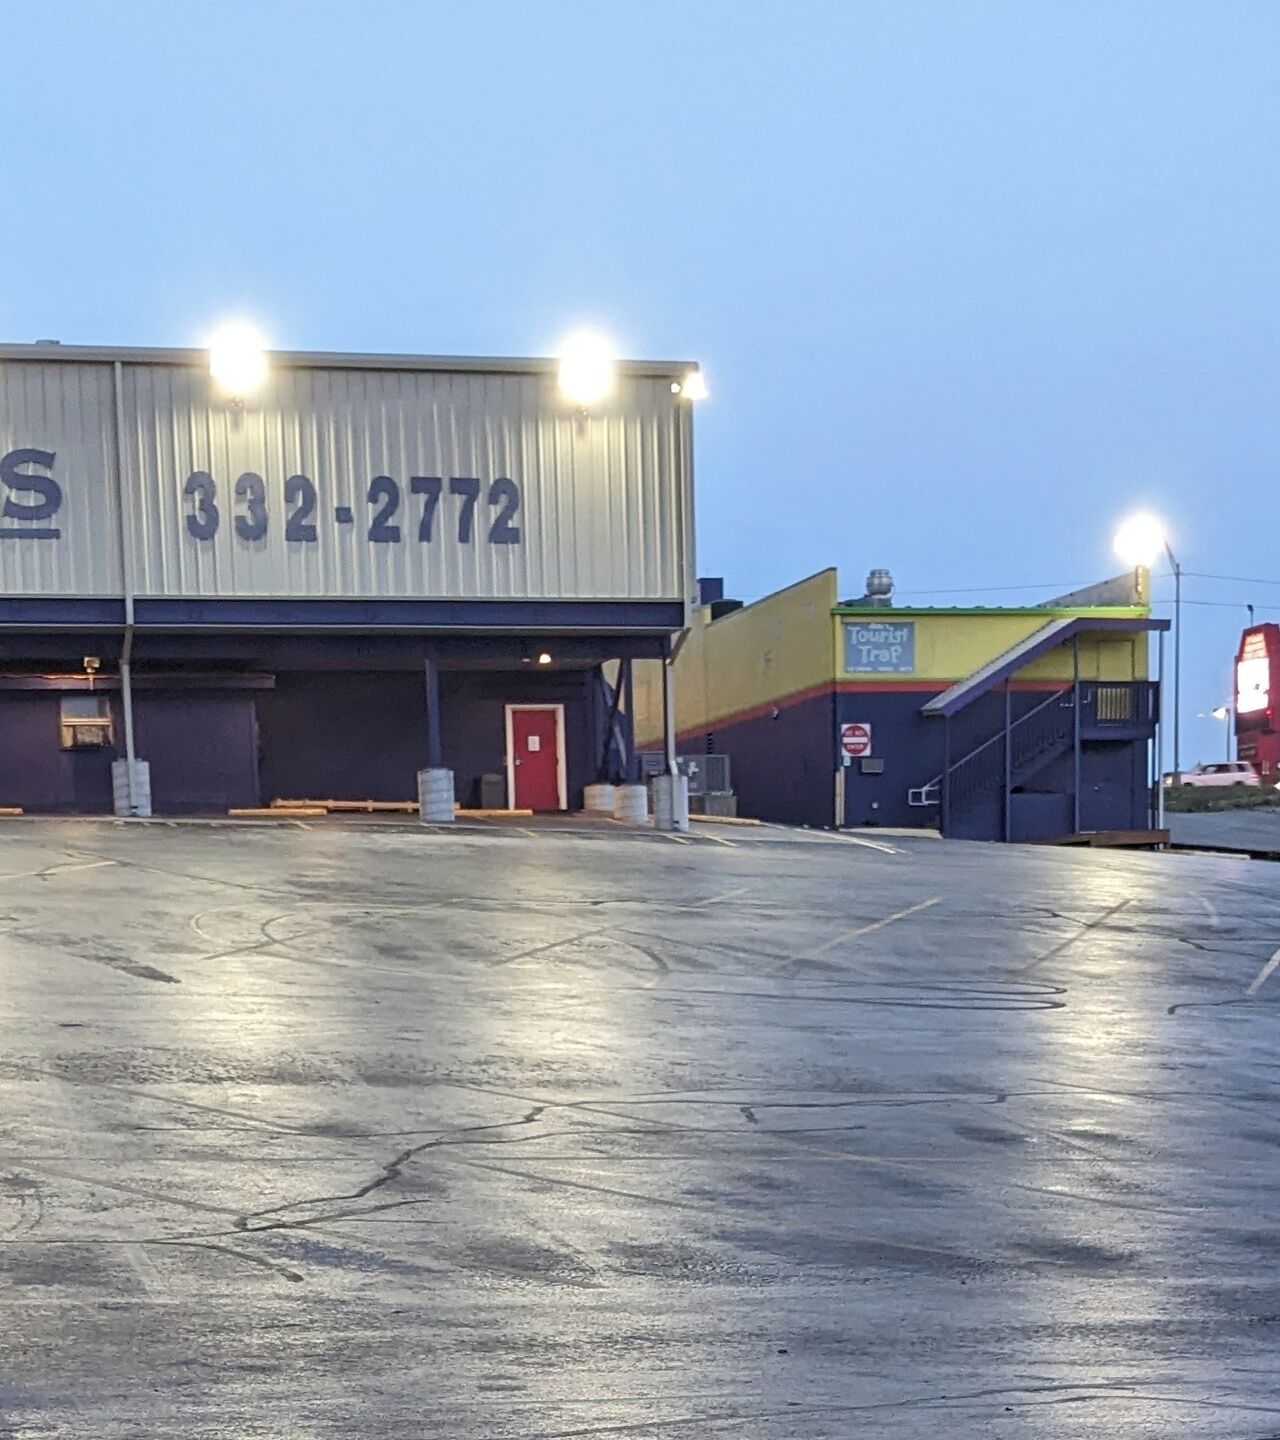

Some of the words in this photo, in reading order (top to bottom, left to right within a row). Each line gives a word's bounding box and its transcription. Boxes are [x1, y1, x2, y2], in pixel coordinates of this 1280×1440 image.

[183, 470, 521, 545] 332-2772
[847, 626, 908, 645] Tourist
[857, 645, 902, 664] Trap
